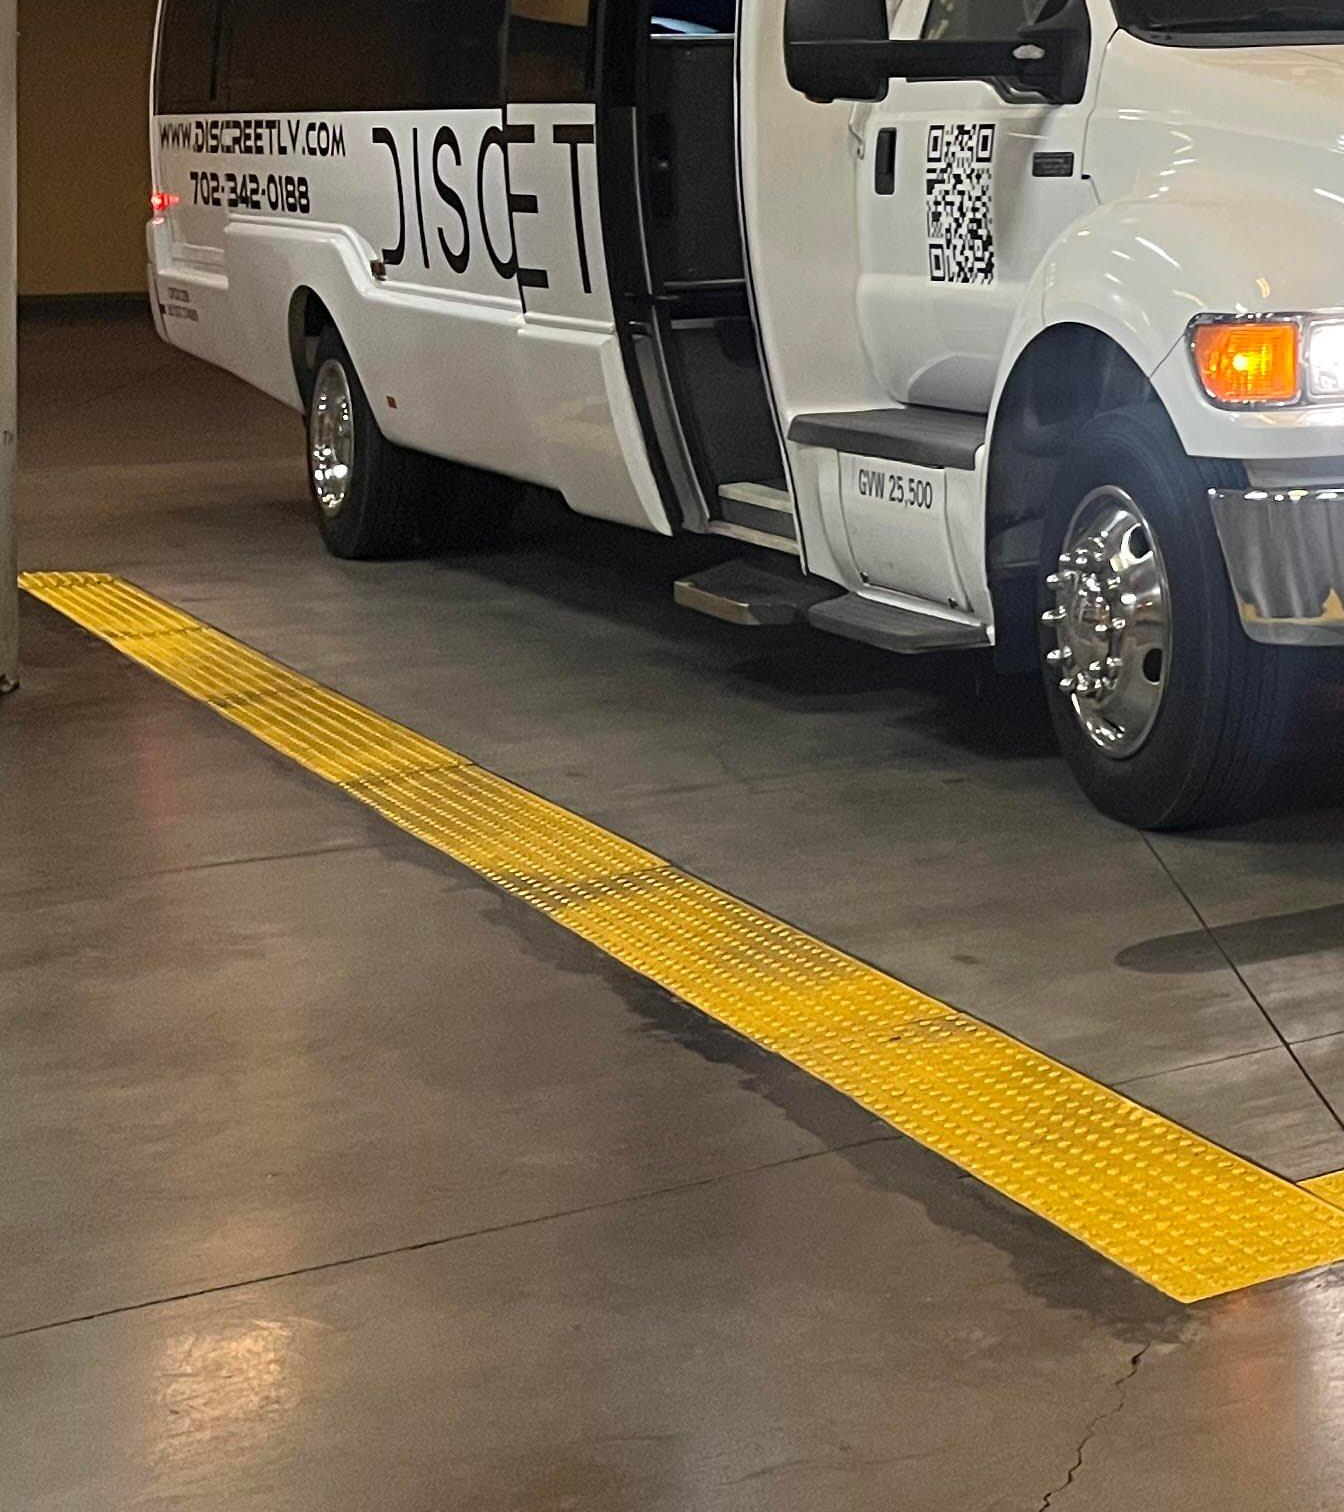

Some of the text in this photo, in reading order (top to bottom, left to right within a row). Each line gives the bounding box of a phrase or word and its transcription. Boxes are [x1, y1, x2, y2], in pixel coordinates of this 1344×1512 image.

[159, 119, 346, 157] WWW.DISCREETLV.COM
[858, 468, 933, 509] GVW 25,500
